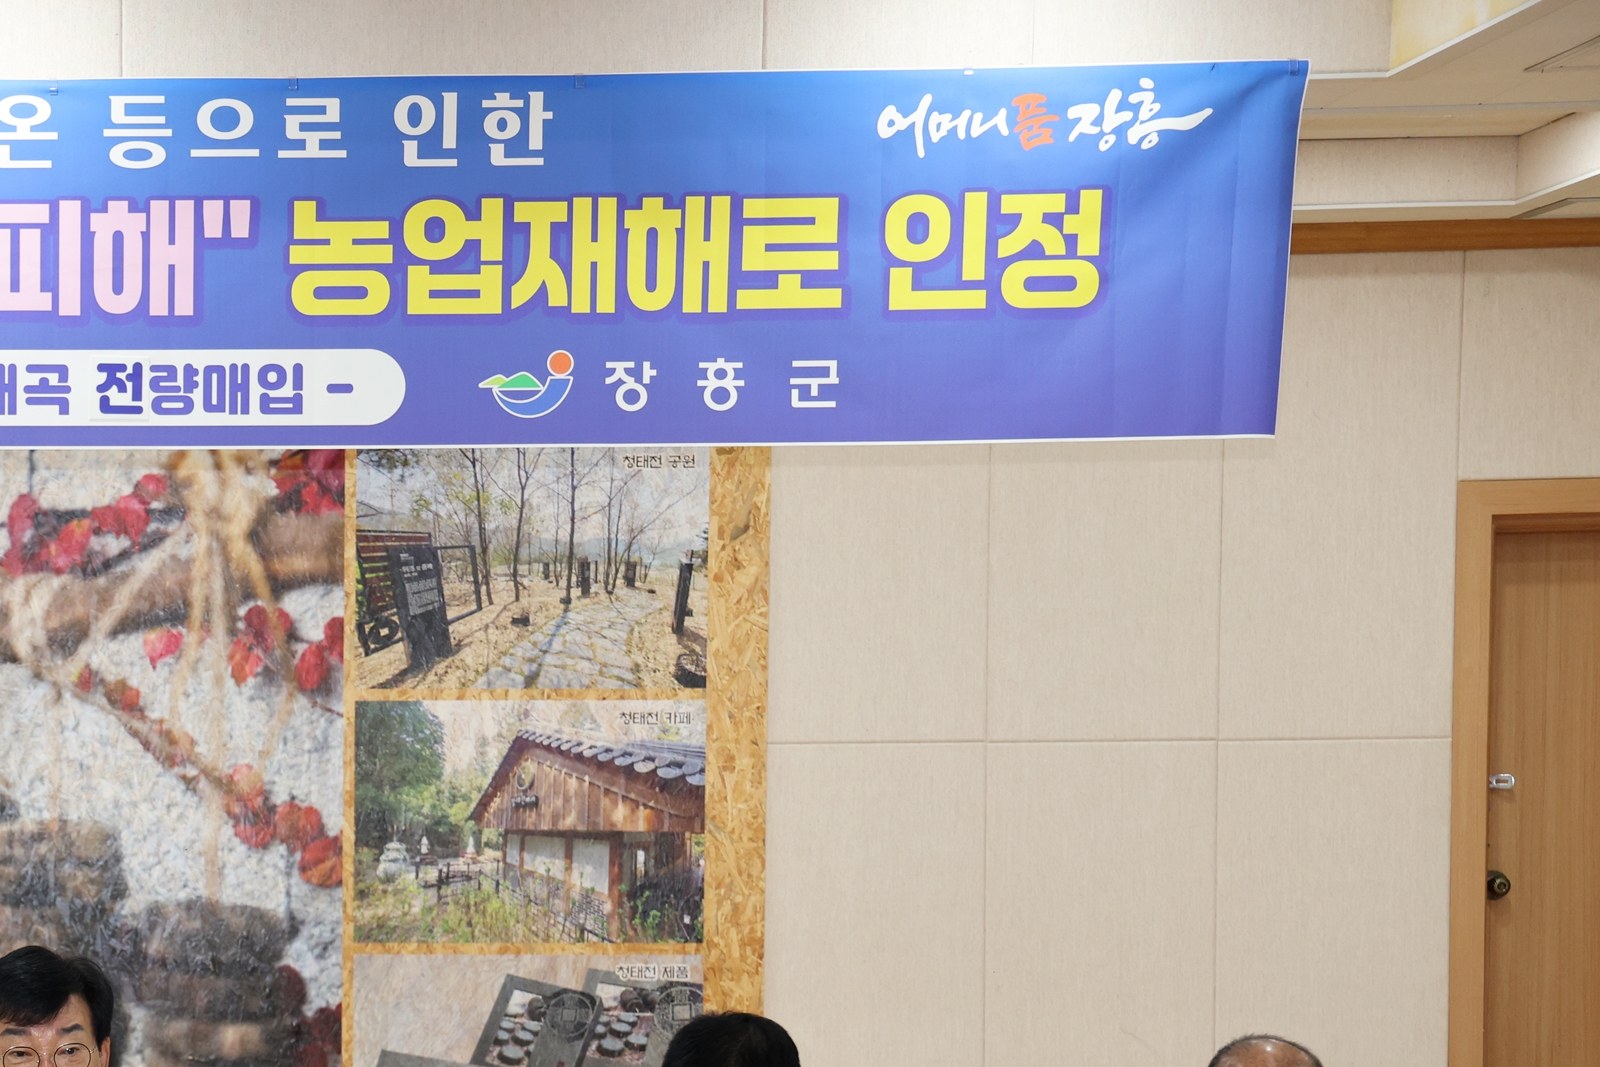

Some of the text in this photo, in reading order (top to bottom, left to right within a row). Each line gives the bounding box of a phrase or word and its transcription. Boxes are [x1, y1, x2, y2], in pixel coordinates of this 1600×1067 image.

[101, 93, 349, 170] 등으로
[393, 90, 554, 169] 인한
[1066, 77, 1215, 155] 장흥
[288, 194, 845, 318] 농업재해로
[883, 188, 1105, 312] 인정
[92, 361, 306, 419] 전량매입
[622, 454, 696, 469] 청태전 공원
[619, 711, 691, 725] 청태전 카페
[616, 965, 689, 979] 청태전 제품
